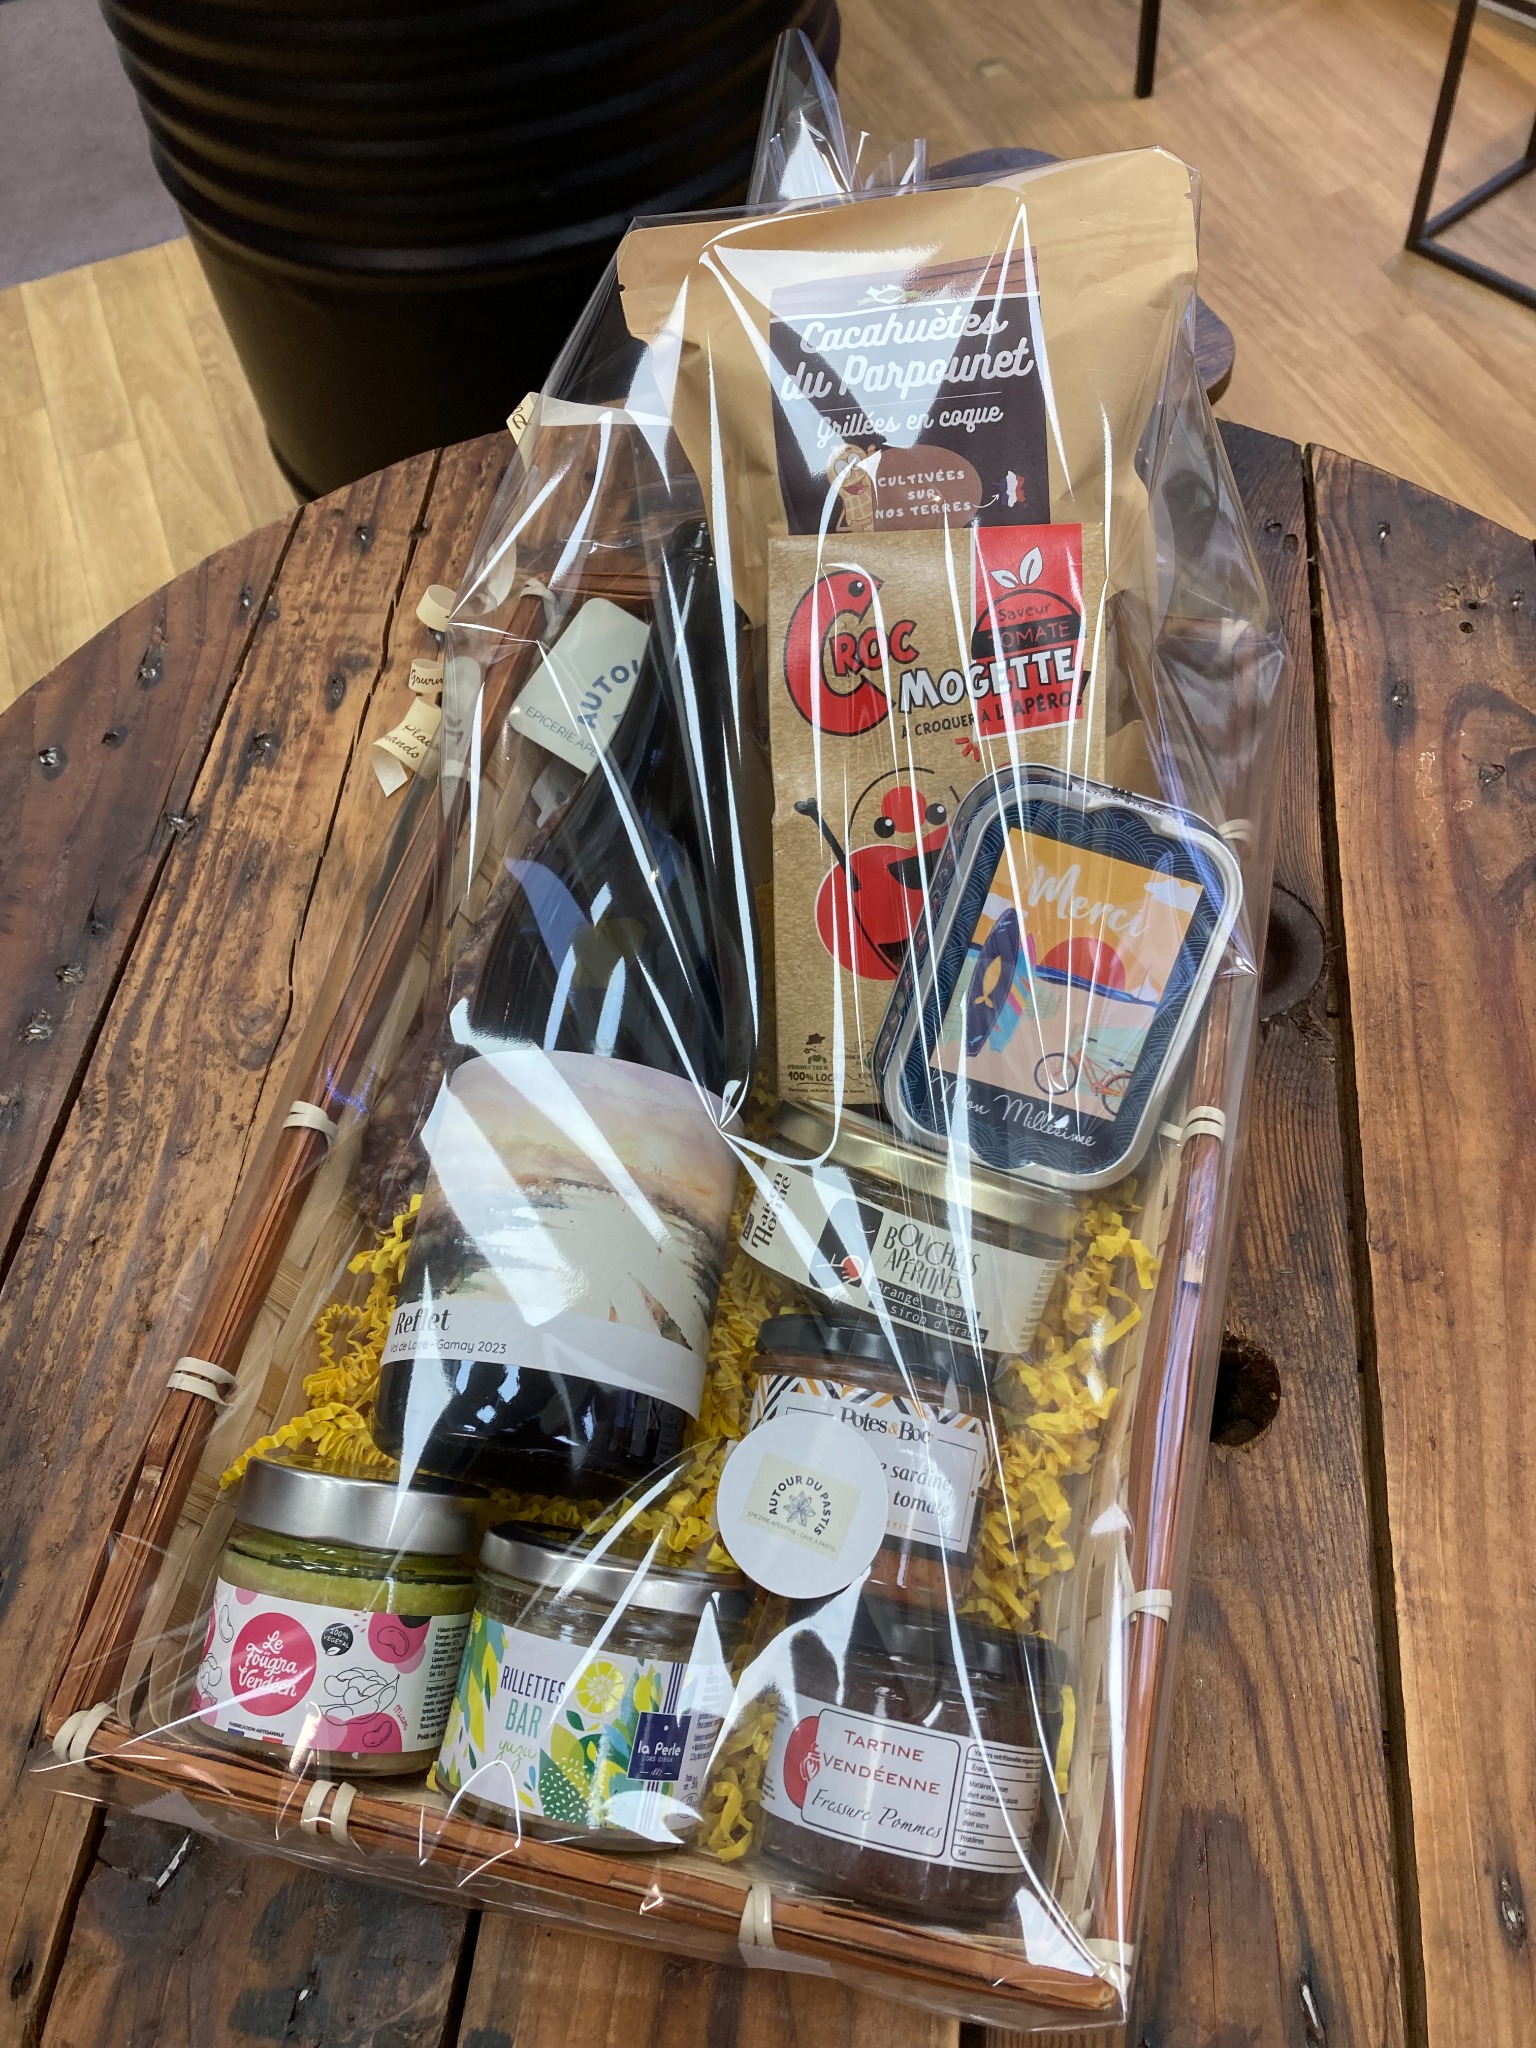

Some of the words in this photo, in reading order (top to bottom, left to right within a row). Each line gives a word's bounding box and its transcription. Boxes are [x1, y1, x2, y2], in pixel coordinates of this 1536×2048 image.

[800, 307, 1009, 353] Cacahuètes
[780, 361, 832, 401] du
[839, 337, 1034, 400] Parpounet
[816, 411, 901, 449] Grillées
[906, 413, 934, 430] en
[939, 405, 1004, 433] coque
[877, 468, 965, 488] CULTIVÉES
[907, 489, 936, 501] SUR
[875, 507, 904, 520] NOS
[910, 500, 972, 517] TERRES
[998, 603, 1051, 621] Saveur
[898, 645, 1075, 714] MOGETTE
[525, 706, 577, 743] EPICERIE
[1026, 864, 1149, 936] Merci
[394, 1307, 451, 1335] Reflet
[437, 1339, 475, 1353] Gamay
[478, 1341, 507, 1354] 2023
[769, 1475, 802, 1515] AUTOUR
[806, 1477, 823, 1491] DU
[813, 1492, 831, 1535] PASTIS
[262, 1630, 284, 1655] Le
[238, 1664, 297, 1697] Vendéen
[500, 1665, 566, 1705] RILLETTES
[393, 1704, 409, 1731] Miam
[505, 1698, 543, 1738] BAR
[637, 1740, 650, 1754] la
[654, 1741, 681, 1756] Perle
[844, 1729, 925, 1763] TARTINE
[822, 1752, 941, 1796] VENDÉENNE
[811, 1788, 872, 1822] Fressure
[878, 1806, 943, 1839] Pommes
